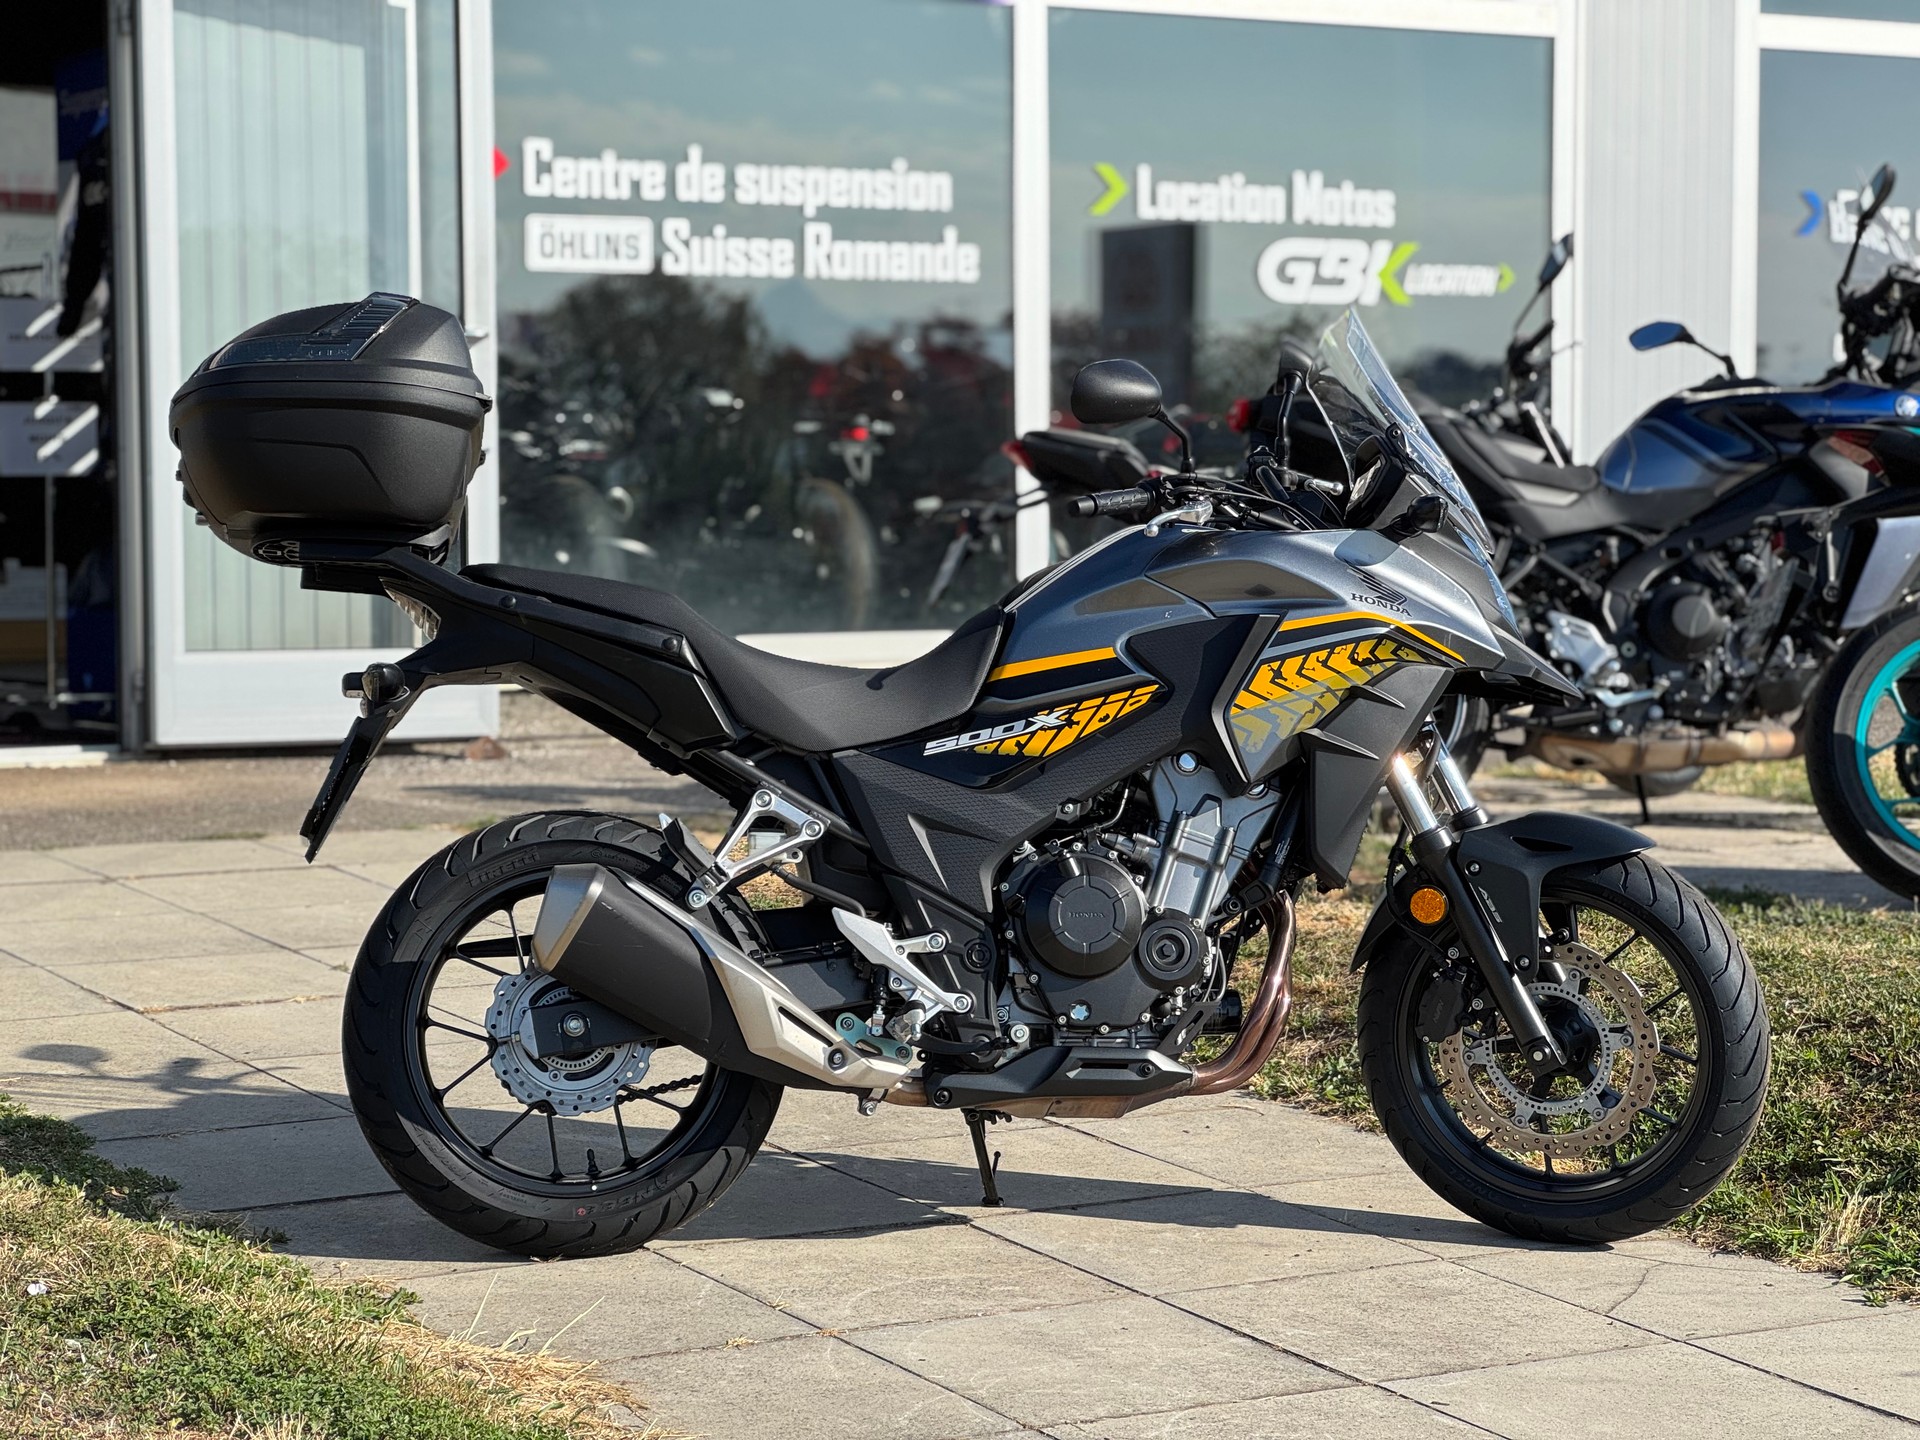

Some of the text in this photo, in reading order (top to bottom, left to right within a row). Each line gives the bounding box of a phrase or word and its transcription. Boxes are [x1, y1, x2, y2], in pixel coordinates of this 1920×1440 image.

[522, 137, 954, 217] Centre de suspension
[1136, 164, 1397, 228] Location Motos
[539, 217, 981, 283] ÖHLINS Suisse Romande
[1403, 262, 1497, 297] LOCATION
[1350, 592, 1413, 618] HONDA
[924, 708, 1069, 756] 500X
[1068, 911, 1106, 919] HONDA
